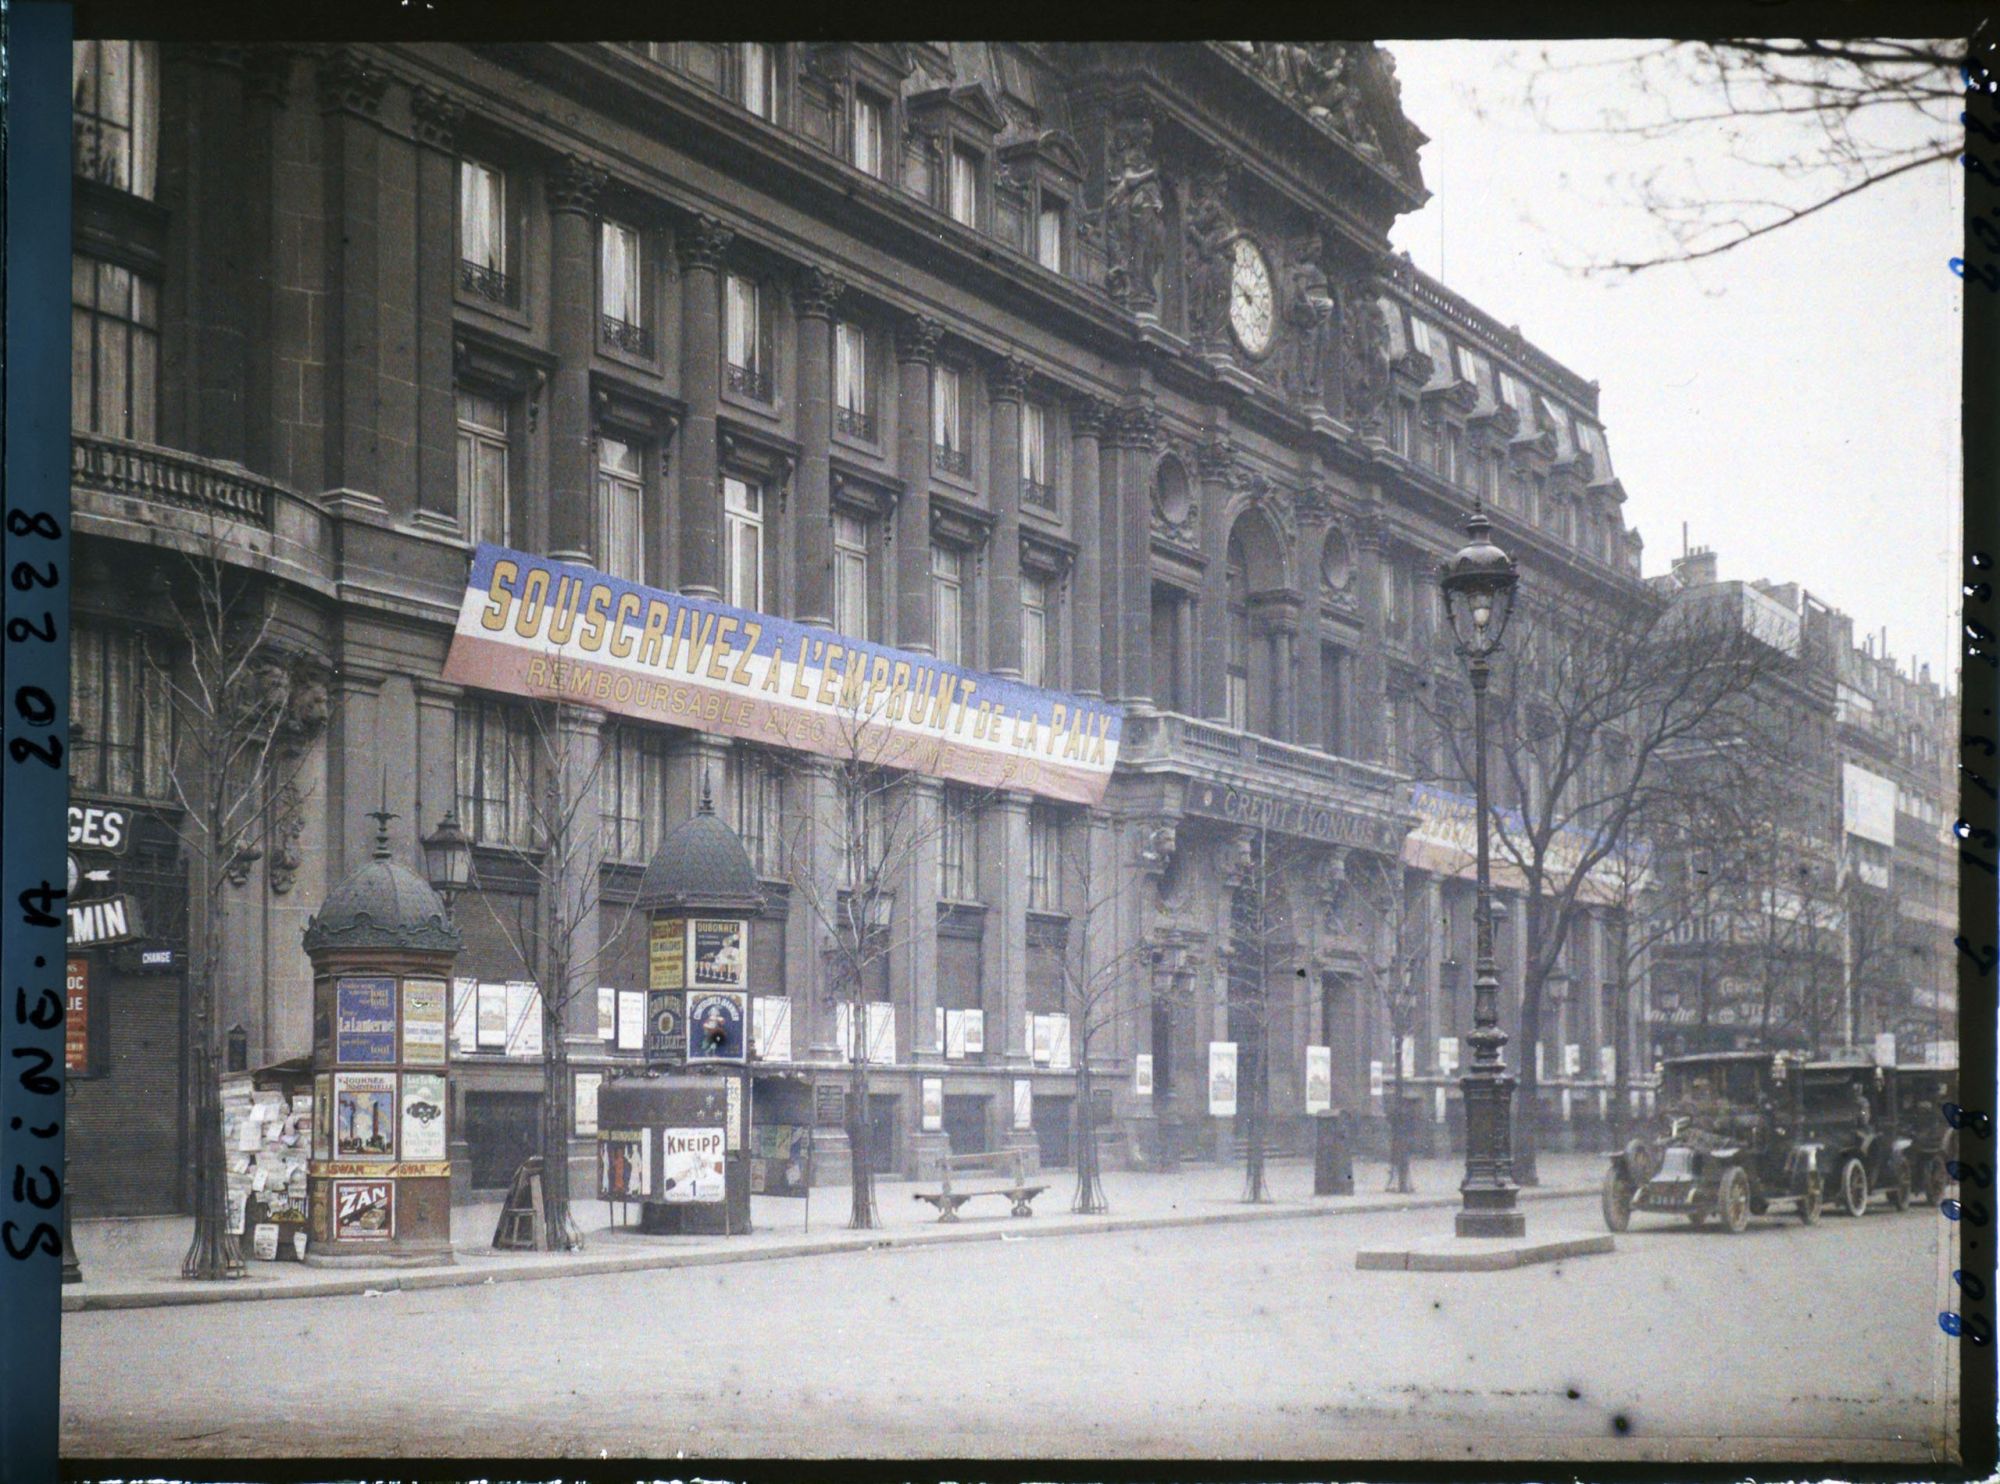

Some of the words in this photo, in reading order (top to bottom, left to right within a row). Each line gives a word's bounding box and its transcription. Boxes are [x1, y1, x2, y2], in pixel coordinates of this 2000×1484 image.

[481, 560, 762, 686] SOUSCRIVEZ
[791, 635, 976, 734] L'EMPRUNT
[974, 700, 1004, 742] DE
[1012, 709, 1037, 751] LA
[1046, 703, 1112, 766] PAIX
[525, 658, 754, 728] REMBOURSABLE
[764, 707, 827, 743] AVEC
[1297, 802, 1375, 843] LYONNAIS
[142, 952, 171, 964] CHANGE
[667, 1135, 720, 1155] KNEIPP
[330, 1164, 365, 1175] SWAN
[400, 1164, 425, 1175] SWAN
[339, 1186, 387, 1219] ZAN
